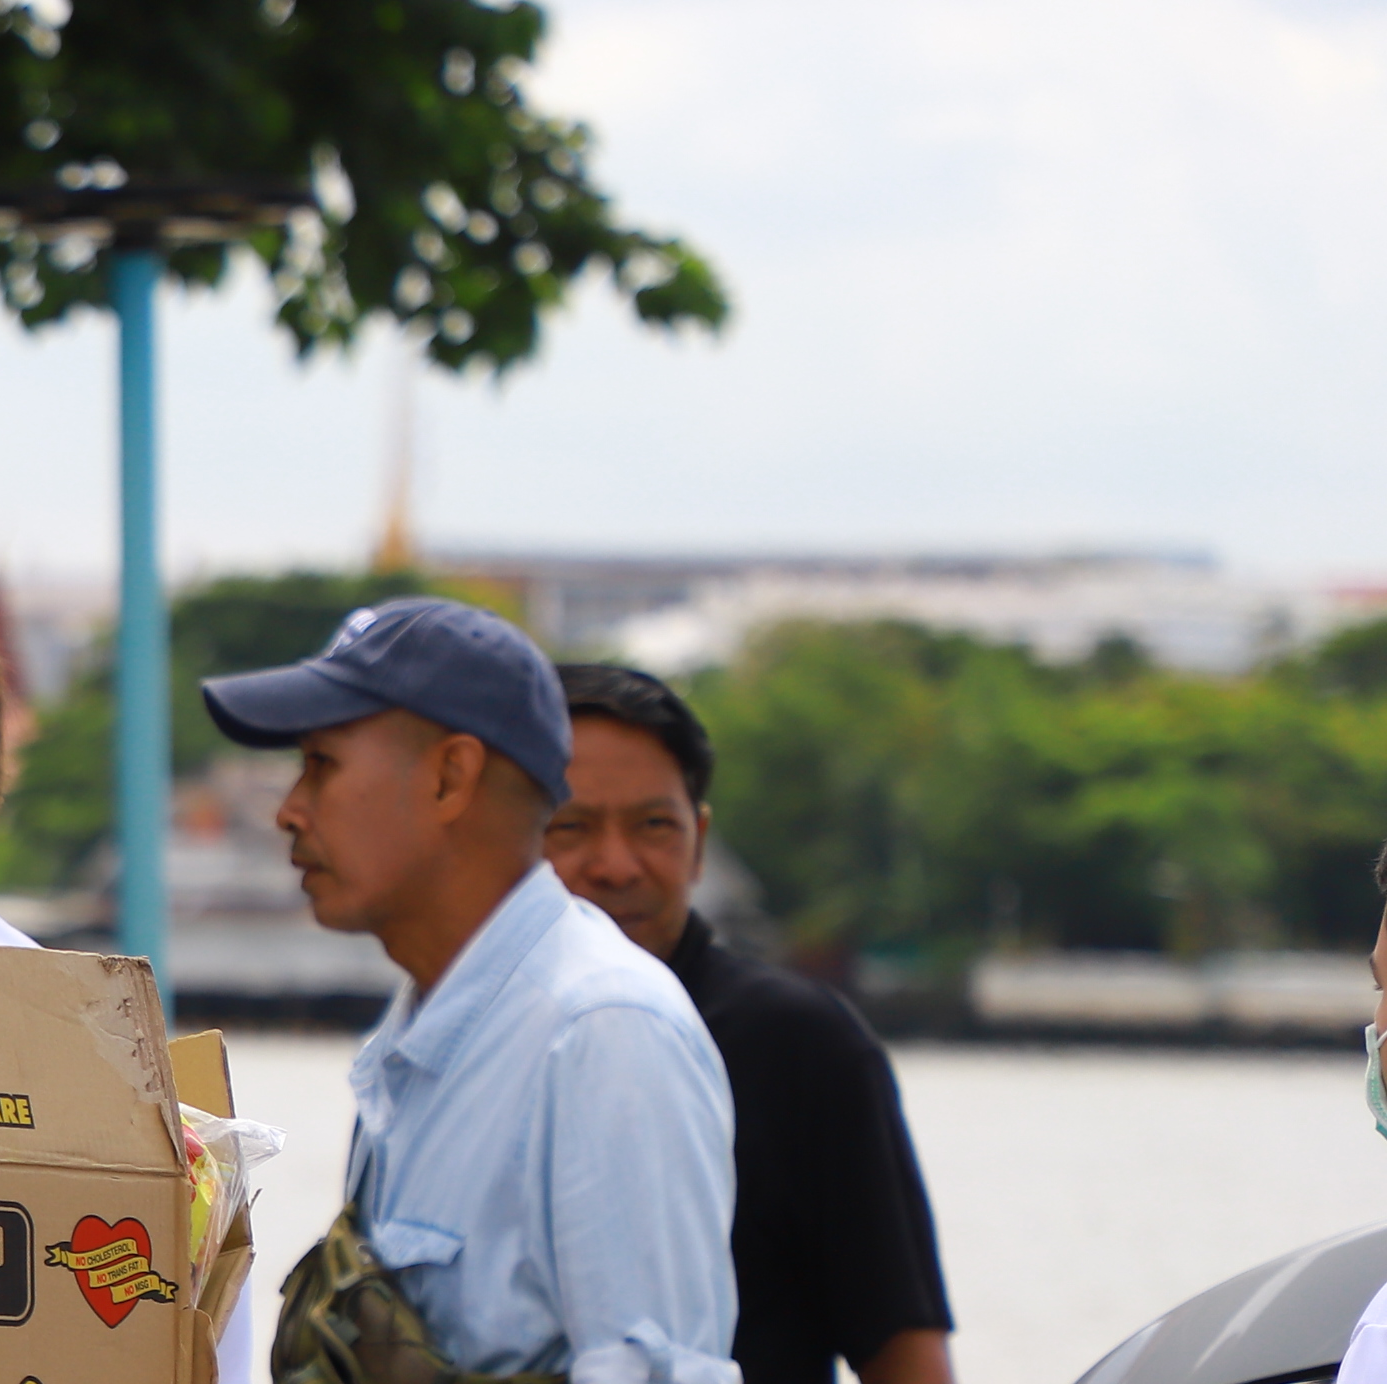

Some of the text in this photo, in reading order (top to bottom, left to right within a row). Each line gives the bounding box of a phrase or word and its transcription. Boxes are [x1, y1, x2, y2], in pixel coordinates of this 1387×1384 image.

[75, 1256, 87, 1267] NO
[96, 1273, 107, 1284] NO
[107, 1265, 128, 1280] TRANS
[124, 1285, 135, 1296] NO
